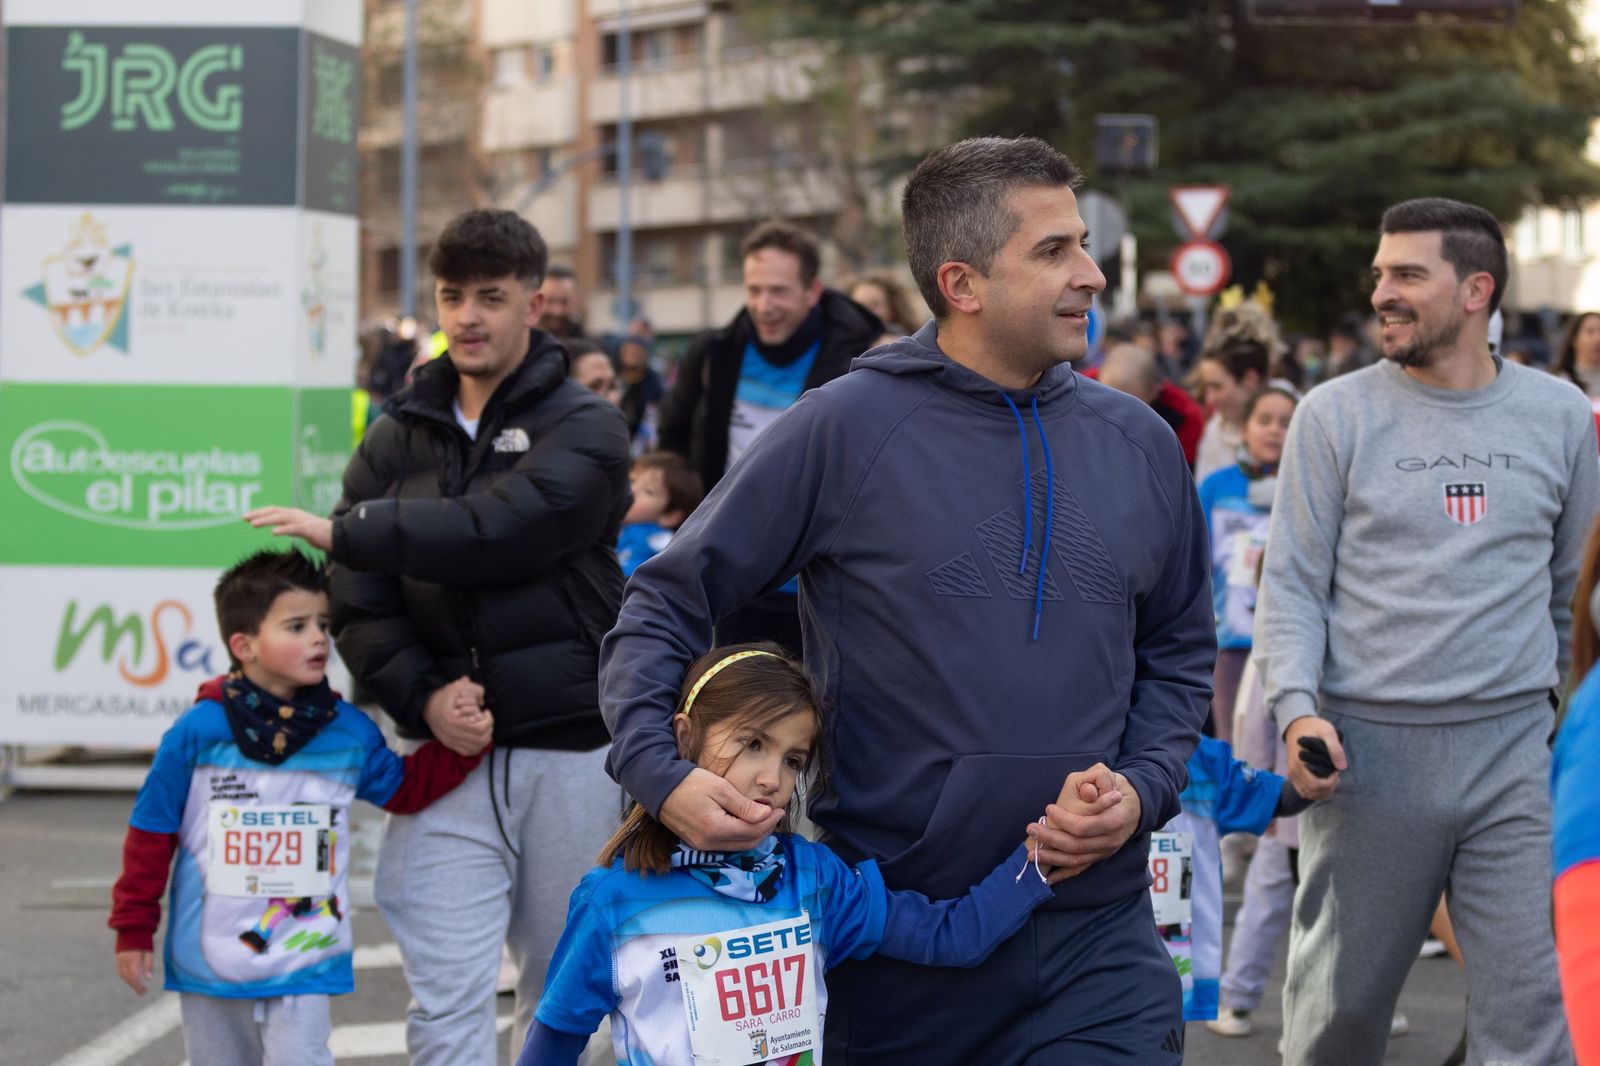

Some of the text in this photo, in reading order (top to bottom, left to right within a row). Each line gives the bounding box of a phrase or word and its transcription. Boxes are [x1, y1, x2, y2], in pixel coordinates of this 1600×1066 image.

[60, 32, 243, 131] JRG
[22, 440, 261, 476] autoescuelas
[1395, 453, 1521, 472] GANT
[85, 473, 132, 513] el
[148, 473, 262, 525] pilar
[242, 811, 319, 826] SETEL
[224, 831, 302, 865] 6629
[1153, 858, 1168, 893] 8
[715, 953, 806, 1022] 6617
[735, 1007, 801, 1032] SARA CARRO
[770, 1028, 811, 1045] Ayuntamiento
[771, 1038, 812, 1054] de Salamanca
